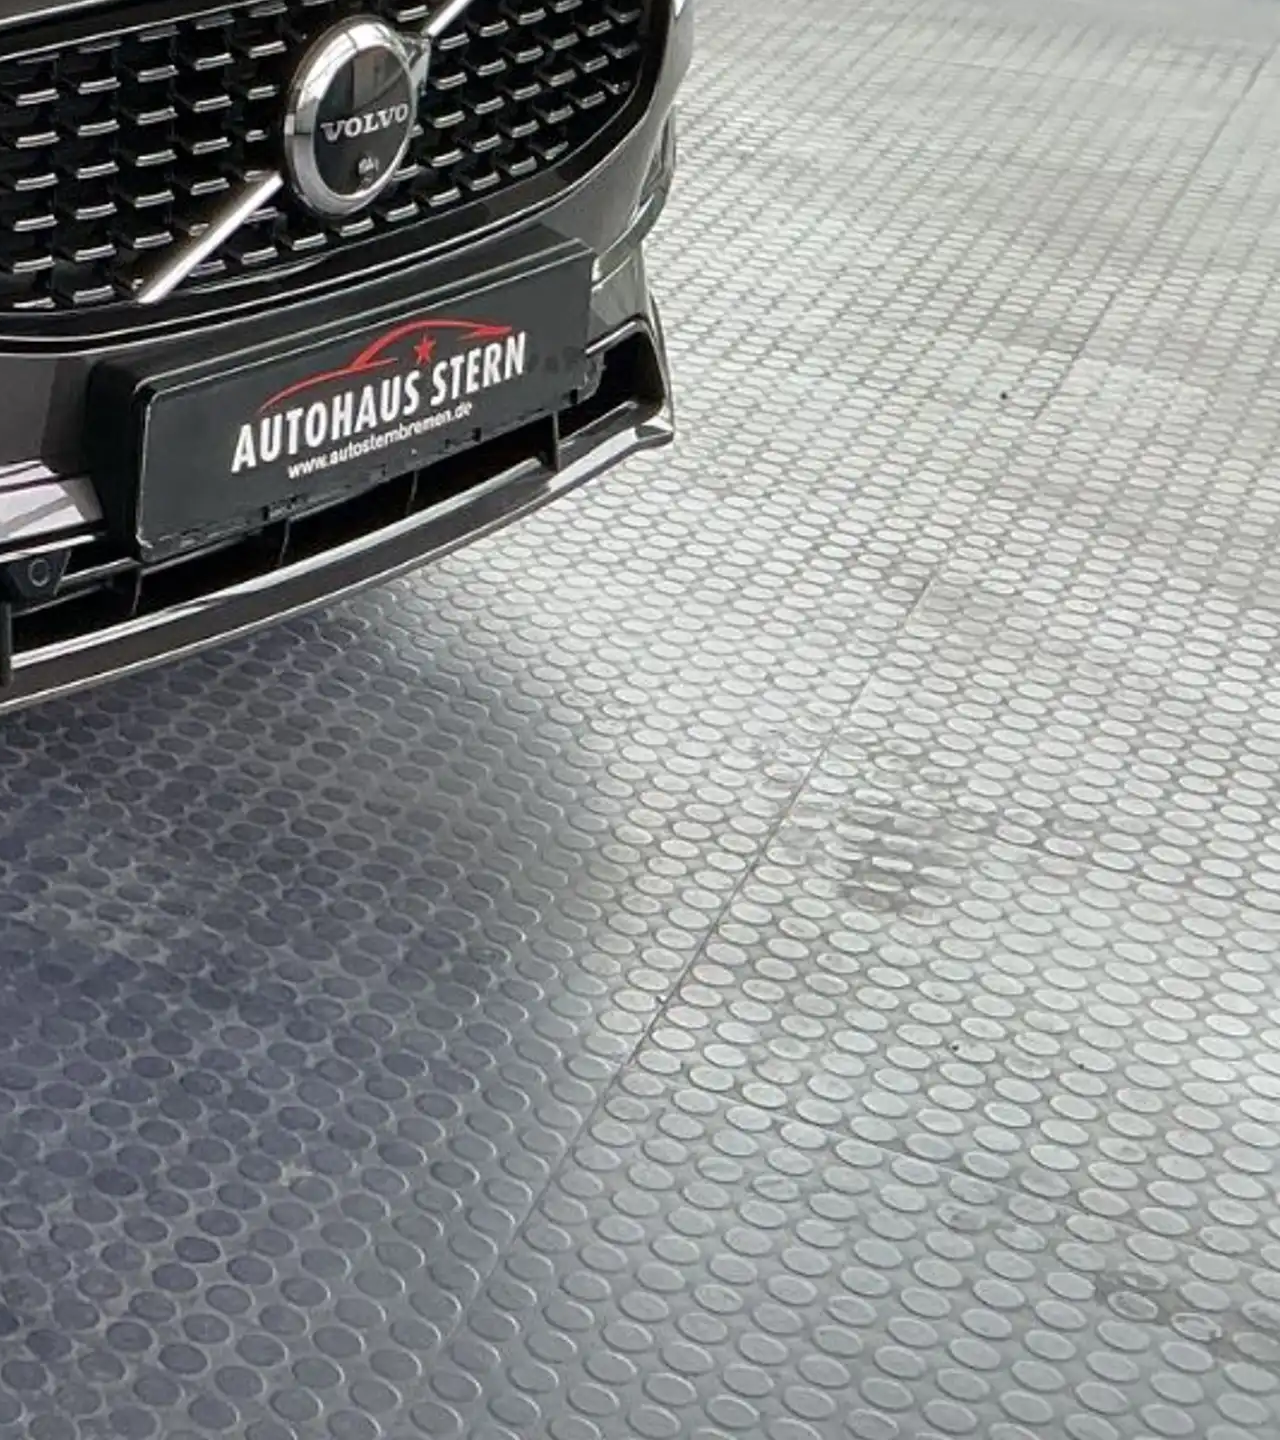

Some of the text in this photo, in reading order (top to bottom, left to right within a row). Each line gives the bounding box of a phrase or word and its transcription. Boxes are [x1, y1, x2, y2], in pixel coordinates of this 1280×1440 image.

[320, 103, 409, 142] VOLVO
[230, 331, 527, 474] AUTOHAUS STERN
[287, 401, 474, 479] www.autosternbremen.de
